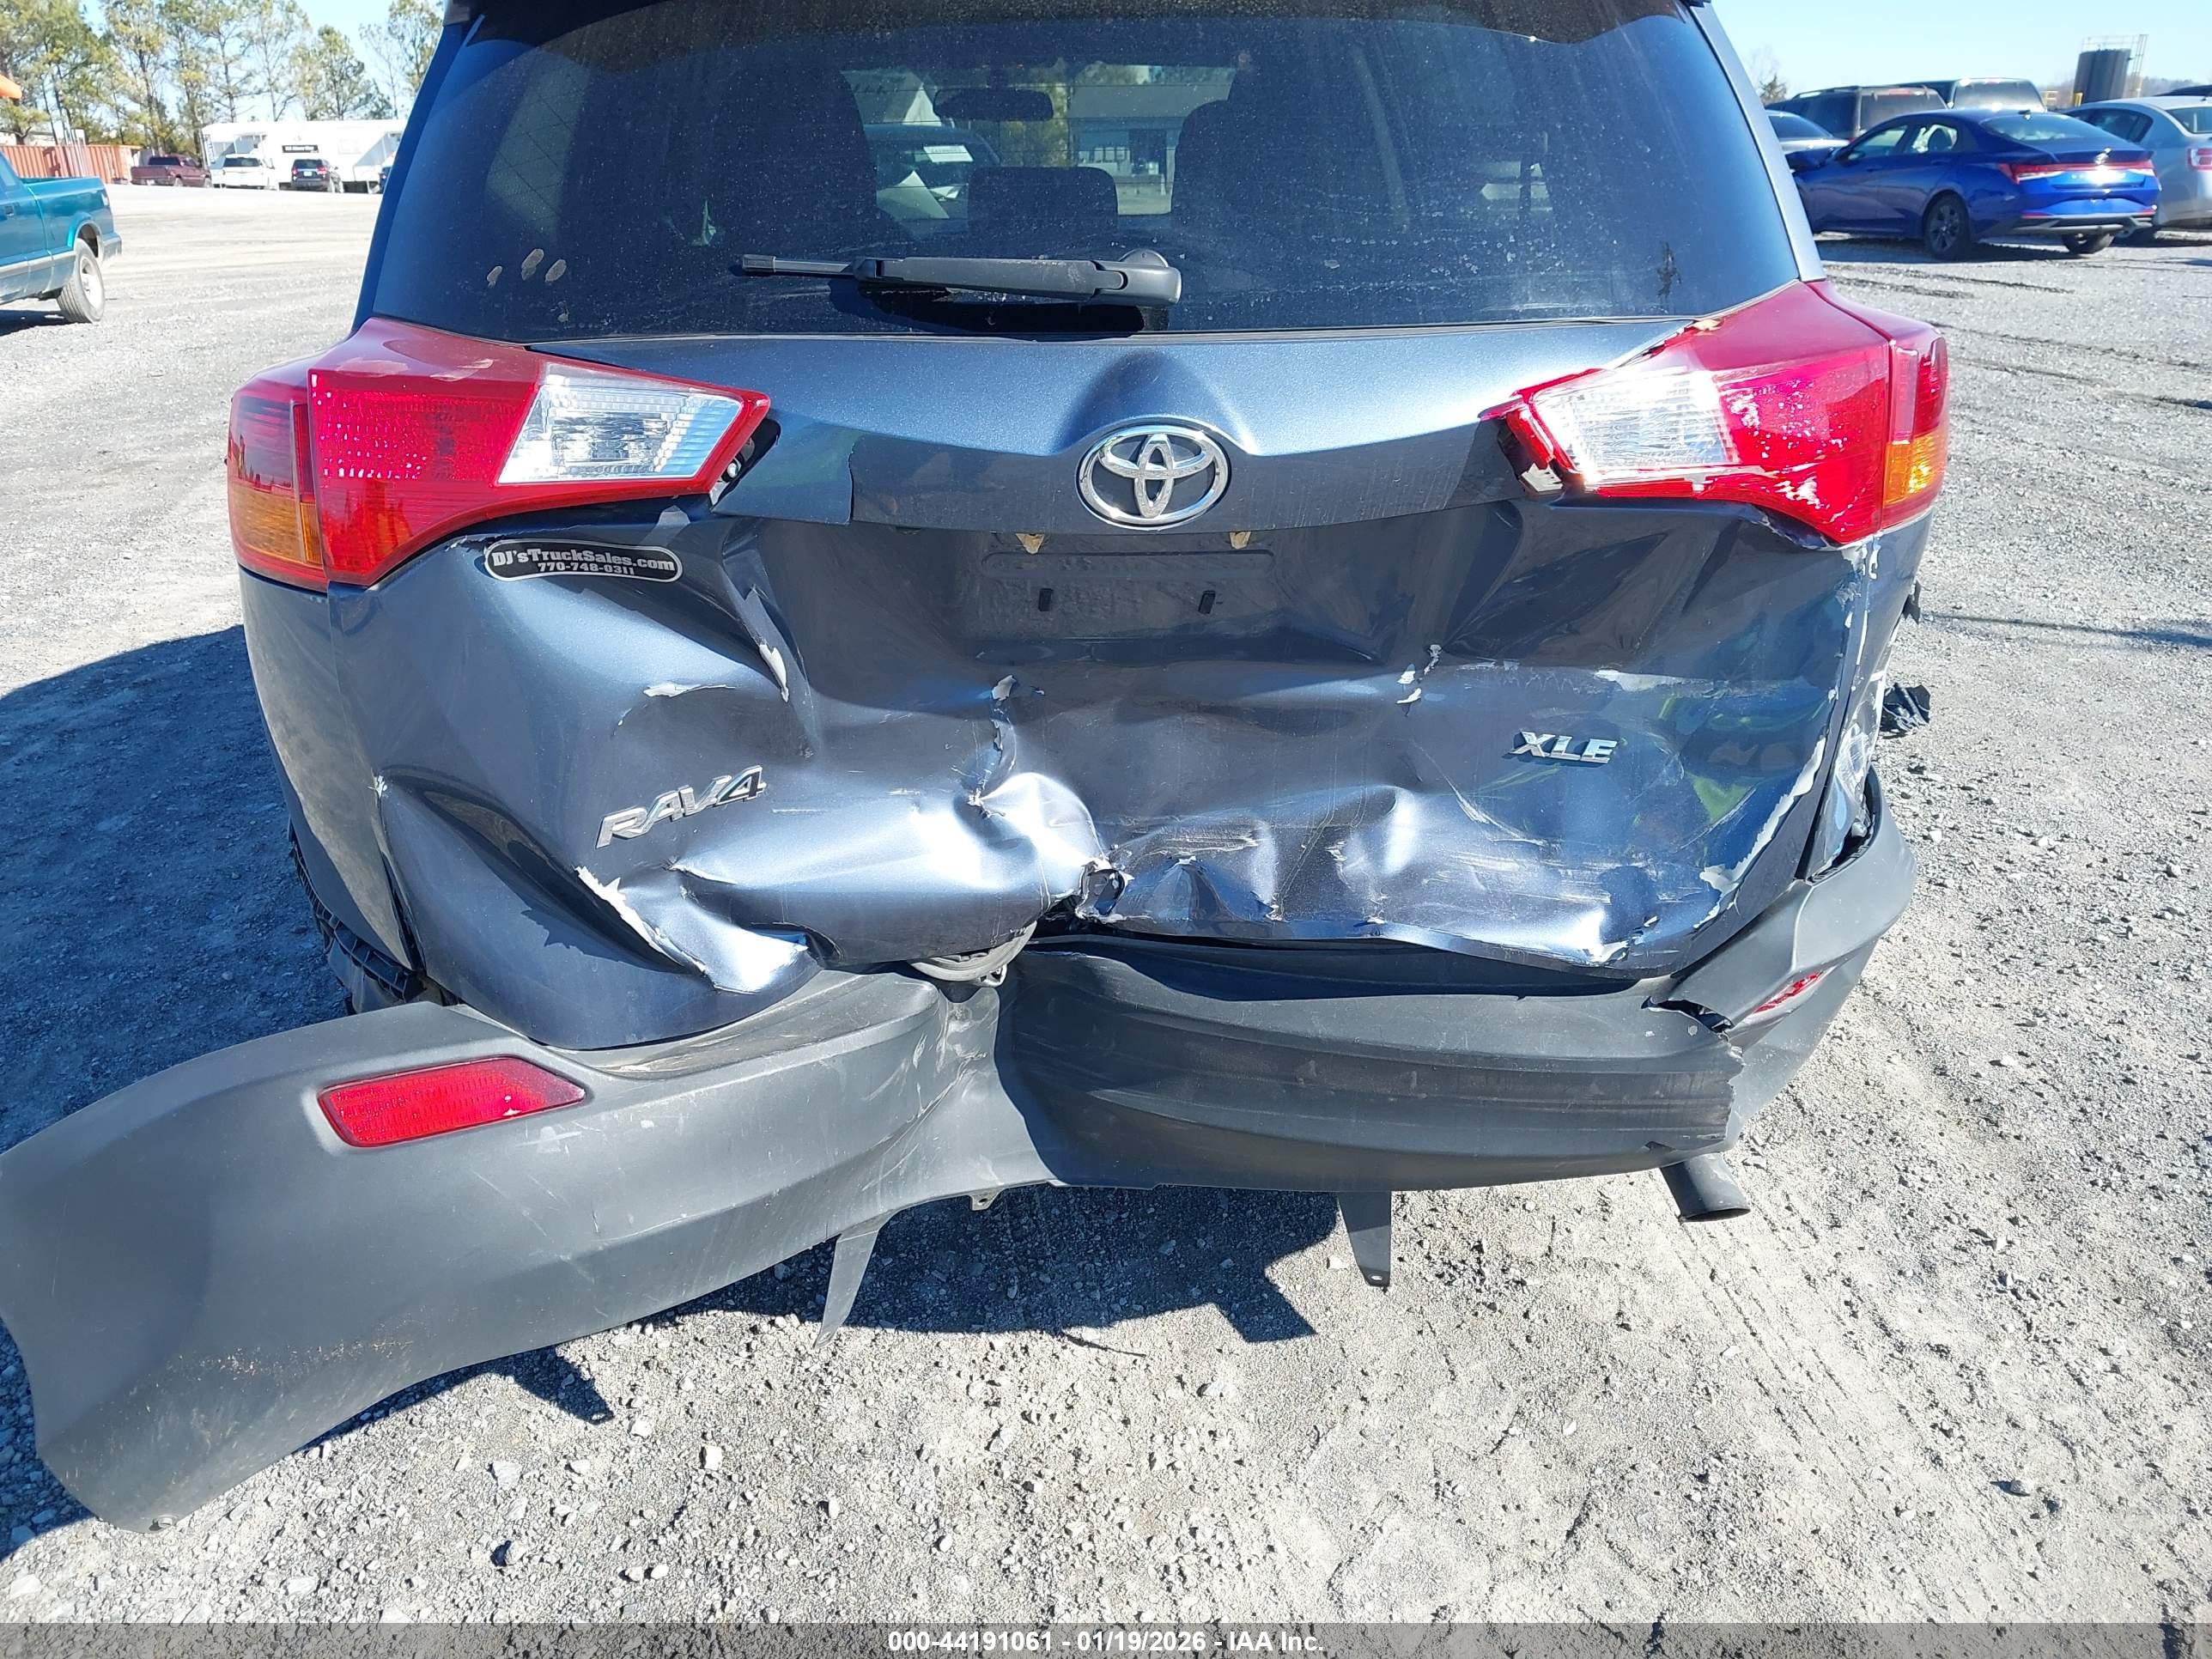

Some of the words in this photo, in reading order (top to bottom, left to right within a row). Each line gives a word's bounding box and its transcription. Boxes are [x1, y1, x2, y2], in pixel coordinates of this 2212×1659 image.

[491, 549, 675, 572] DJ'sTruckSales.com
[538, 562, 635, 575] 770-748-0311
[1507, 729, 1618, 764] XLE
[595, 764, 767, 849] RAV4
